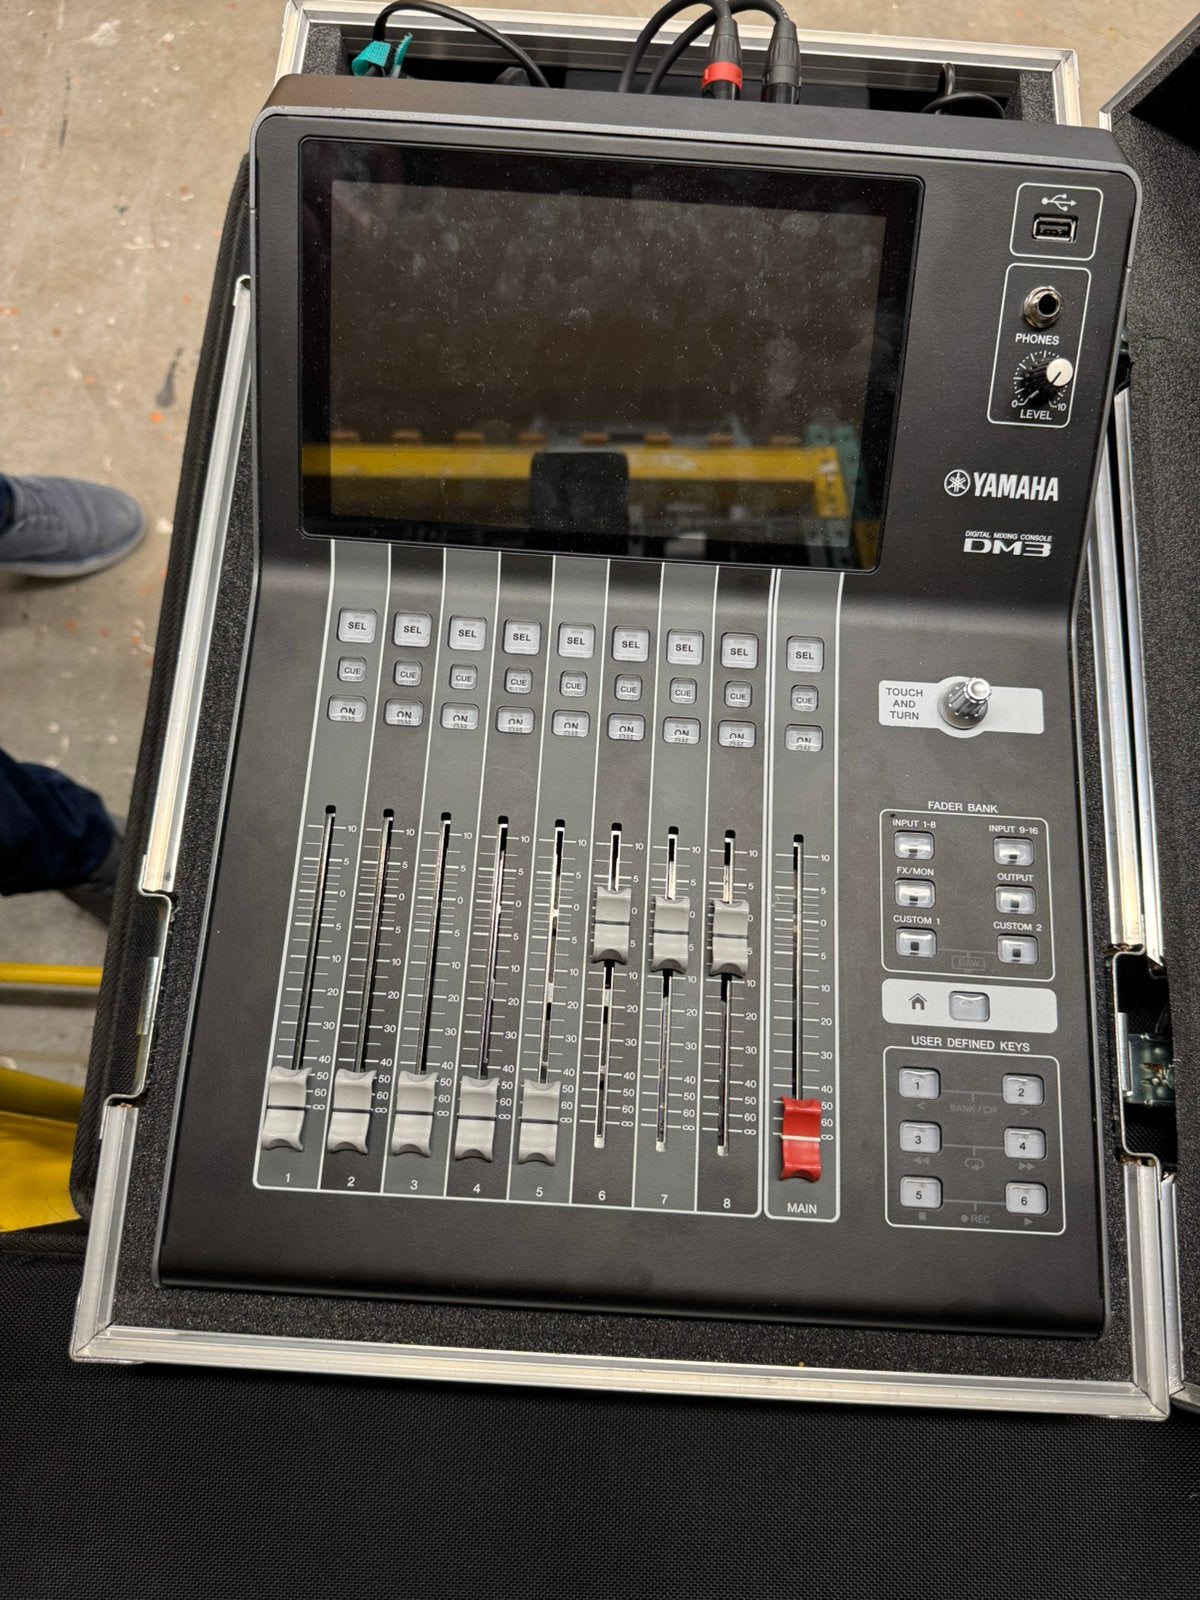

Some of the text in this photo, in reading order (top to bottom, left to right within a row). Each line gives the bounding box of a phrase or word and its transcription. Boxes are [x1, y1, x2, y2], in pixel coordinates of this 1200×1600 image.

[1015, 333, 1059, 345] PHONES
[1011, 400, 1018, 408] 0
[1057, 403, 1067, 411] 10
[1020, 409, 1052, 420] LEVEL
[974, 472, 1058, 501] YAMAHA
[993, 532, 1018, 540] MIXING
[1020, 534, 1052, 542] CONSOLE
[964, 538, 1051, 557] DM3
[348, 621, 366, 630] SEL
[403, 626, 421, 634] SEL
[458, 629, 476, 638] SEL
[513, 633, 531, 641] SEL
[567, 637, 585, 645] SEL
[622, 640, 640, 648] SEL
[675, 644, 693, 652] SEL
[730, 648, 748, 656] SEL
[796, 651, 814, 660] SEL
[565, 682, 581, 690] CUE
[675, 689, 691, 697] CUE
[886, 688, 923, 697] TOUCH
[893, 700, 915, 708] AND
[340, 707, 355, 715] ON
[397, 711, 412, 719] ON
[890, 711, 919, 720] TURN
[928, 801, 998, 813] FADER BANK
[893, 819, 919, 827] INPUT
[989, 825, 1038, 834] INPUT 9-16
[692, 846, 701, 854] 10
[897, 867, 934, 875] FX/MON
[633, 875, 639, 883] 5
[997, 873, 1033, 882] OUTPUT
[399, 893, 405, 901] 0
[457, 896, 463, 904] 0
[515, 900, 522, 908] 0
[573, 903, 580, 911] 0
[820, 919, 826, 927] 0
[893, 915, 932, 924] CUSTOM
[993, 921, 1032, 930] CUSTOM
[332, 955, 341, 963] 10
[392, 958, 401, 966] 10
[452, 961, 461, 969] 10
[511, 965, 520, 973] 10
[570, 968, 579, 976] 10
[629, 972, 638, 980] 10
[327, 988, 339, 996] 20
[388, 991, 399, 999] 20
[448, 994, 459, 1002] 20
[508, 998, 519, 1006] 20
[567, 1001, 579, 1009] 20
[627, 1005, 638, 1013] 20
[746, 1012, 757, 1021] 20
[323, 1021, 335, 1030] 30
[821, 1017, 832, 1026] 20
[384, 1024, 396, 1033] 30
[445, 1028, 457, 1036] 30
[505, 1031, 517, 1039] 30
[565, 1035, 577, 1043] 30
[625, 1038, 637, 1046] 30
[685, 1042, 697, 1050] 30
[912, 1036, 1030, 1052] USER DEFINED KEYS
[745, 1046, 757, 1054] 30
[319, 1055, 331, 1063] 40
[821, 1051, 833, 1060] 30
[380, 1058, 392, 1066] 40
[441, 1061, 453, 1069] 40
[502, 1065, 514, 1073] 40
[563, 1068, 575, 1076] 40
[317, 1072, 329, 1080] 50
[379, 1075, 391, 1083] 50
[623, 1072, 635, 1080] 40
[684, 1076, 696, 1084] 40
[440, 1078, 452, 1086] 50
[501, 1081, 513, 1089] 50
[745, 1080, 757, 1088] 40
[915, 1082, 919, 1090] 1
[315, 1088, 327, 1097] 60
[562, 1085, 574, 1093] 50
[623, 1088, 635, 1097] 50
[821, 1085, 833, 1093] 40
[1018, 1088, 1024, 1097] 2
[377, 1091, 389, 1100] 60
[438, 1094, 450, 1103] 60
[684, 1092, 695, 1101] 50
[500, 1098, 512, 1106] 60
[745, 1096, 757, 1105] 50
[561, 1101, 573, 1110] 60
[622, 1105, 634, 1113] 60
[821, 1102, 833, 1110] 50
[683, 1109, 695, 1117] 60
[744, 1113, 756, 1122] 60
[821, 1118, 833, 1127] 60
[915, 1135, 921, 1144] 3
[1019, 1142, 1026, 1150] 4
[286, 1173, 290, 1183] 1
[347, 1176, 355, 1186] 2
[410, 1180, 418, 1190] 3
[473, 1184, 480, 1193] 4
[536, 1187, 543, 1197] 5
[598, 1190, 606, 1201] 6
[916, 1191, 922, 1200] 5
[661, 1194, 668, 1204] 7
[723, 1198, 731, 1208] 8
[1021, 1196, 1028, 1206] 6
[787, 1203, 817, 1214] MAIN
[971, 1214, 990, 1224] REC
